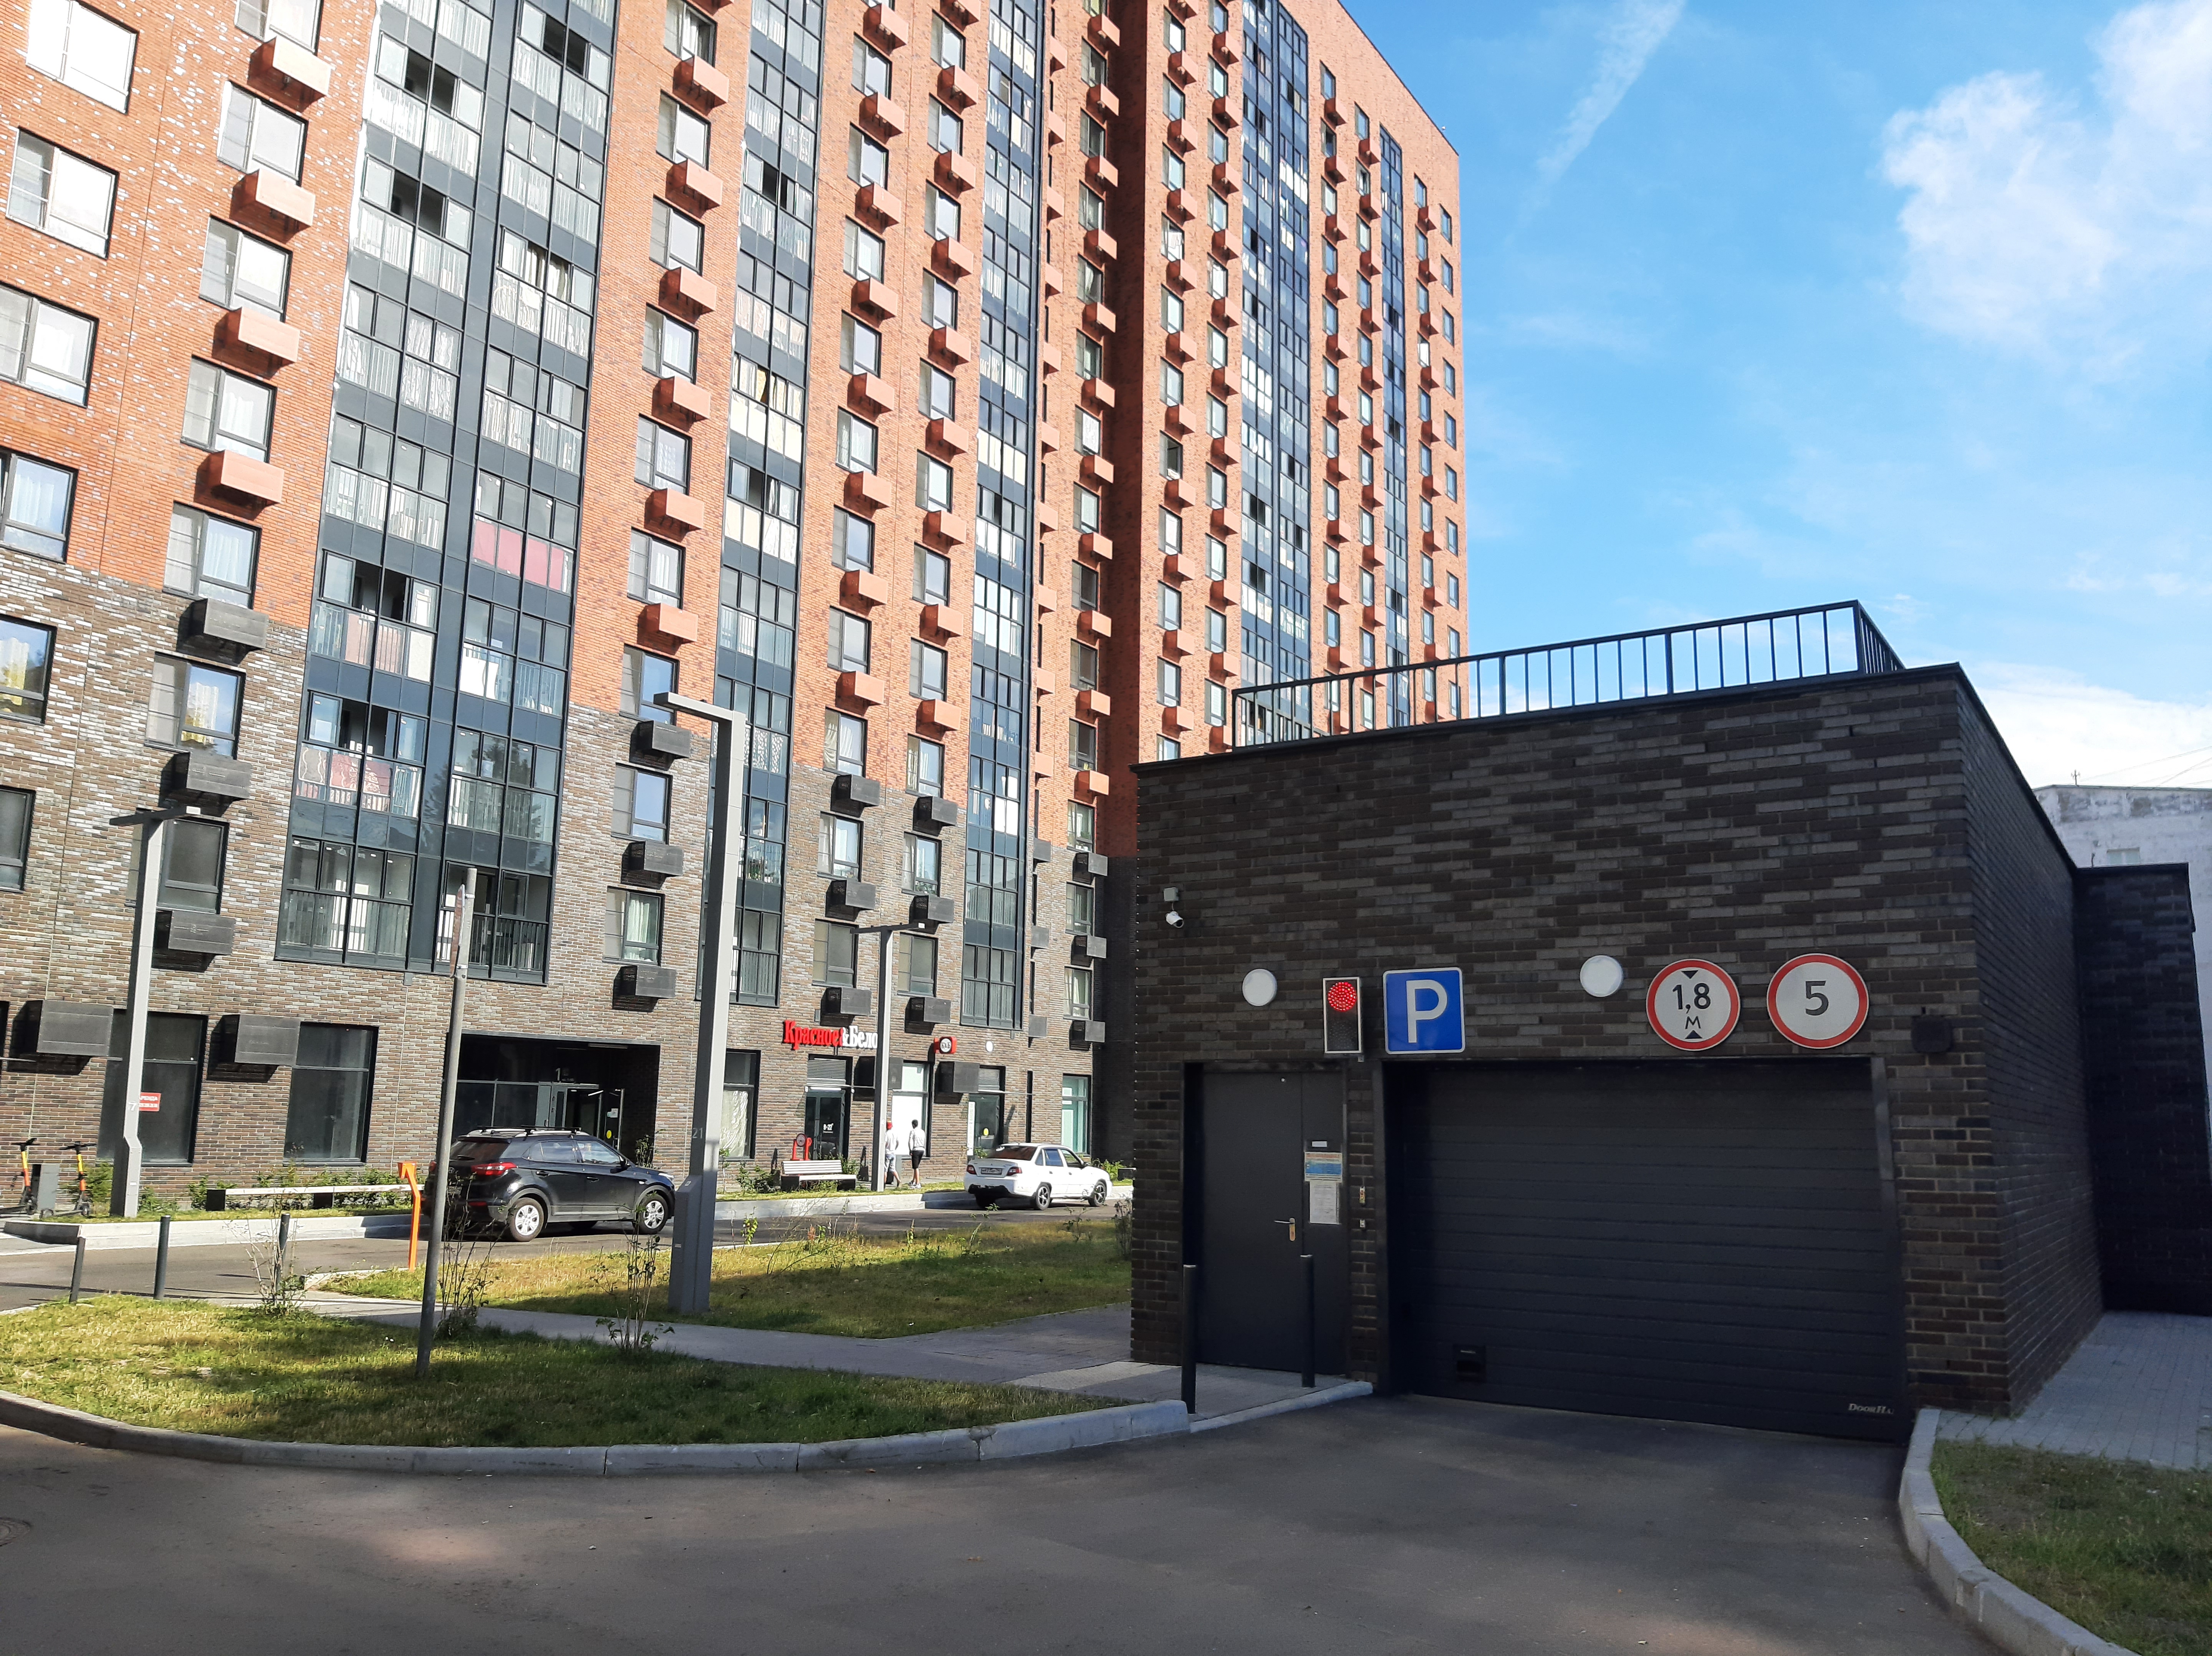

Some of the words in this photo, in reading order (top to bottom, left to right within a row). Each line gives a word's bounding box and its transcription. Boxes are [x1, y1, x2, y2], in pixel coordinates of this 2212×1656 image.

[1805, 980, 1829, 1016] 5
[1406, 979, 1447, 1043] P
[128, 1102, 137, 1111] 7
[692, 1127, 703, 1139] 21
